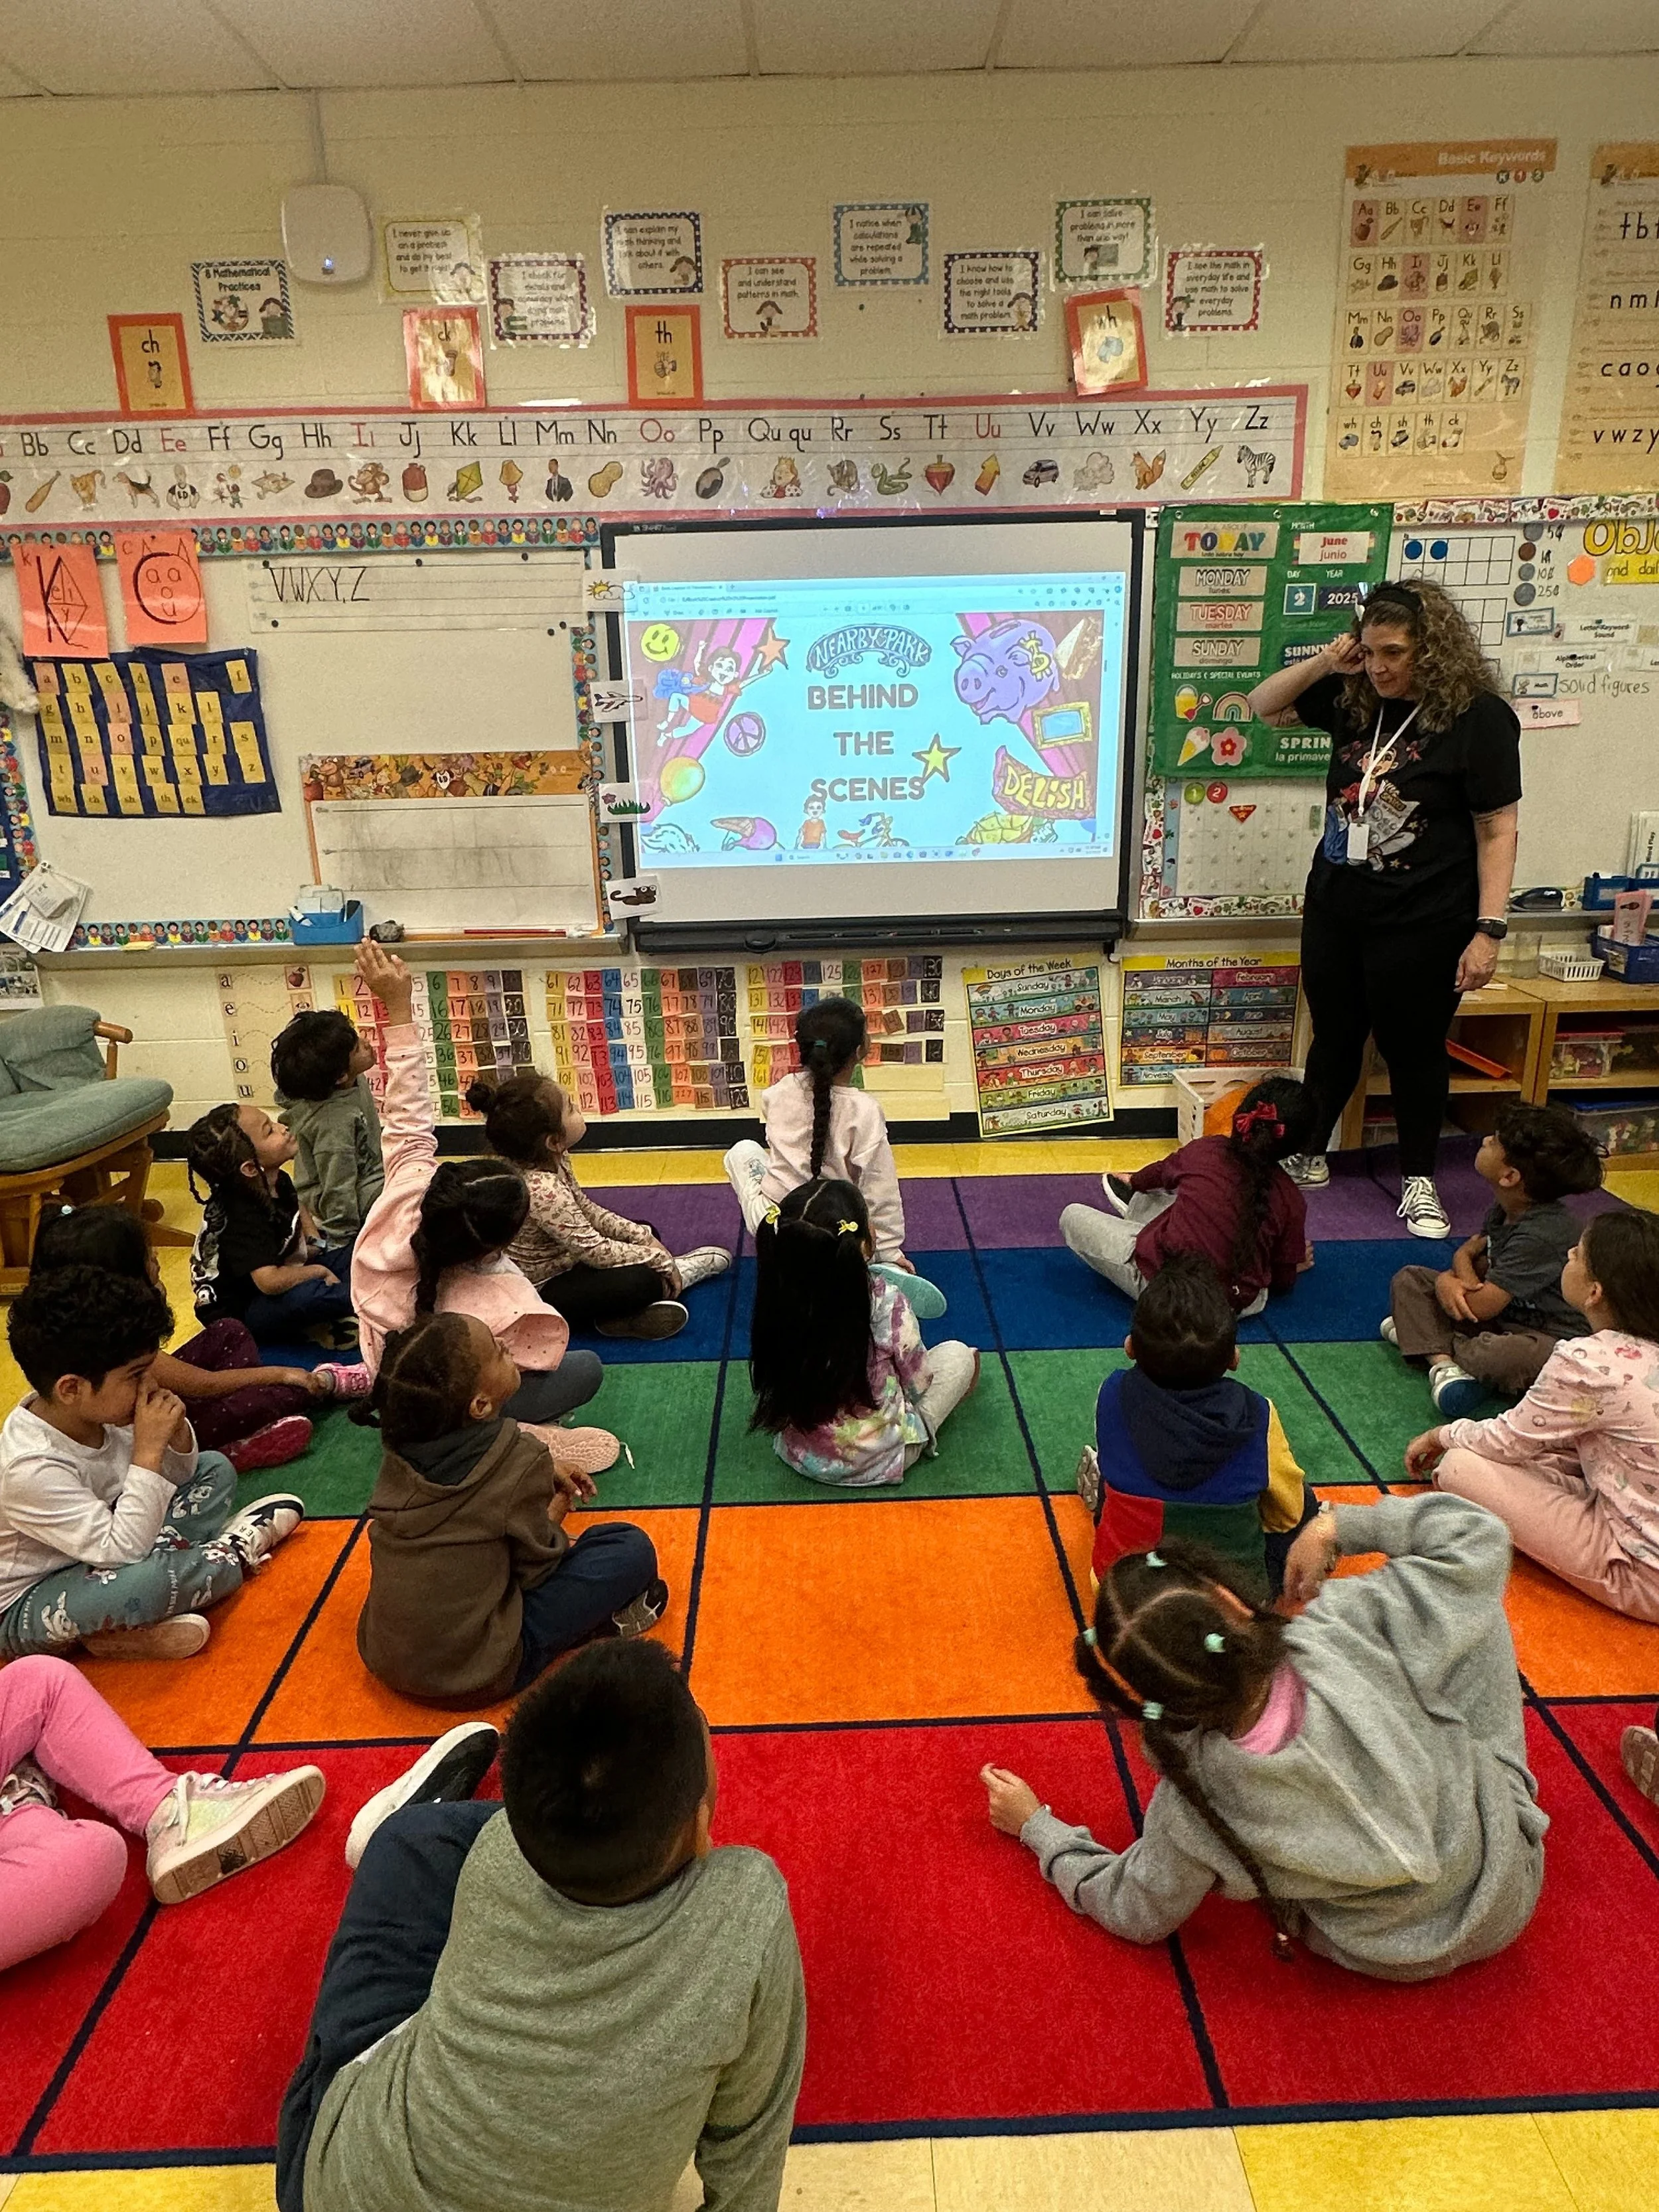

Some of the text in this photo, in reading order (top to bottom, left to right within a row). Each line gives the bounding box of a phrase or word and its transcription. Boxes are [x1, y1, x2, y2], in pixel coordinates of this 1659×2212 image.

[1480, 149, 1547, 166] Keywords
[1439, 199, 1455, 213] Dd
[867, 243, 902, 252] repeated
[213, 266, 271, 278] Mathematical
[1186, 273, 1220, 284] everyday
[218, 281, 261, 293] Practices
[737, 277, 797, 287] and understand
[737, 291, 770, 301] patterns
[1096, 305, 1118, 331] wh
[437, 321, 453, 342] ck
[654, 321, 672, 344] th
[141, 329, 160, 354] ch
[21, 405, 1269, 461] Bb Cc Dd Ee Ff Gg Hh Ii Jj Kk Ll Mm Nn Oo Pp Qu qu Rr Ss Tt Uu Vv Ww Xx Yy Zz
[1185, 532, 1266, 552] TODAY
[1321, 536, 1348, 548] June
[1319, 550, 1347, 561] junio
[1287, 569, 1344, 579] DAY YEAR
[1607, 559, 1659, 576] and dail
[1195, 569, 1251, 587] MONDAY
[1293, 591, 1359, 607] 2 2025
[1190, 603, 1253, 622] TUESDAY
[816, 628, 883, 667] NEARBY
[1192, 640, 1244, 657] SUNDAY
[72, 673, 113, 684] b c
[1171, 671, 1202, 680] HOLIDAYS
[1601, 673, 1650, 698] figures
[808, 684, 918, 710] BEHIND
[1532, 708, 1563, 719] above
[50, 733, 250, 744] m o s
[833, 731, 895, 756] THE
[1279, 737, 1331, 749] SPRIN
[1275, 752, 1331, 764] la primave
[811, 776, 925, 802] SCENES
[987, 959, 1072, 980] Days of the Week
[1167, 956, 1263, 969] Months of the Year
[823, 964, 842, 980] 125
[220, 975, 230, 988] a
[411, 975, 461, 992] 5 6 7
[567, 972, 638, 992] 62 65
[1017, 980, 1049, 992] Sunday
[224, 1002, 235, 1015] e
[451, 999, 465, 1016] 17
[567, 996, 678, 1016] 72 75 77
[1020, 1004, 1056, 1015] Monday
[1159, 1013, 1176, 1023] May
[454, 1025, 470, 1040] 27
[624, 1018, 680, 1035] 85 87
[1020, 1023, 1056, 1035] Tuesday
[231, 1030, 238, 1046] i
[1157, 1029, 1173, 1039] July
[458, 1046, 473, 1063] 37
[572, 1044, 590, 1062] 92
[1017, 1043, 1066, 1058] Wednesday
[1143, 1051, 1187, 1060] September
[1231, 1048, 1268, 1058] October
[236, 1060, 246, 1071] o
[1021, 1065, 1063, 1078] Thursday
[239, 1086, 252, 1098] u
[1028, 1087, 1056, 1099] Friday
[1026, 1107, 1067, 1121] Saturday
